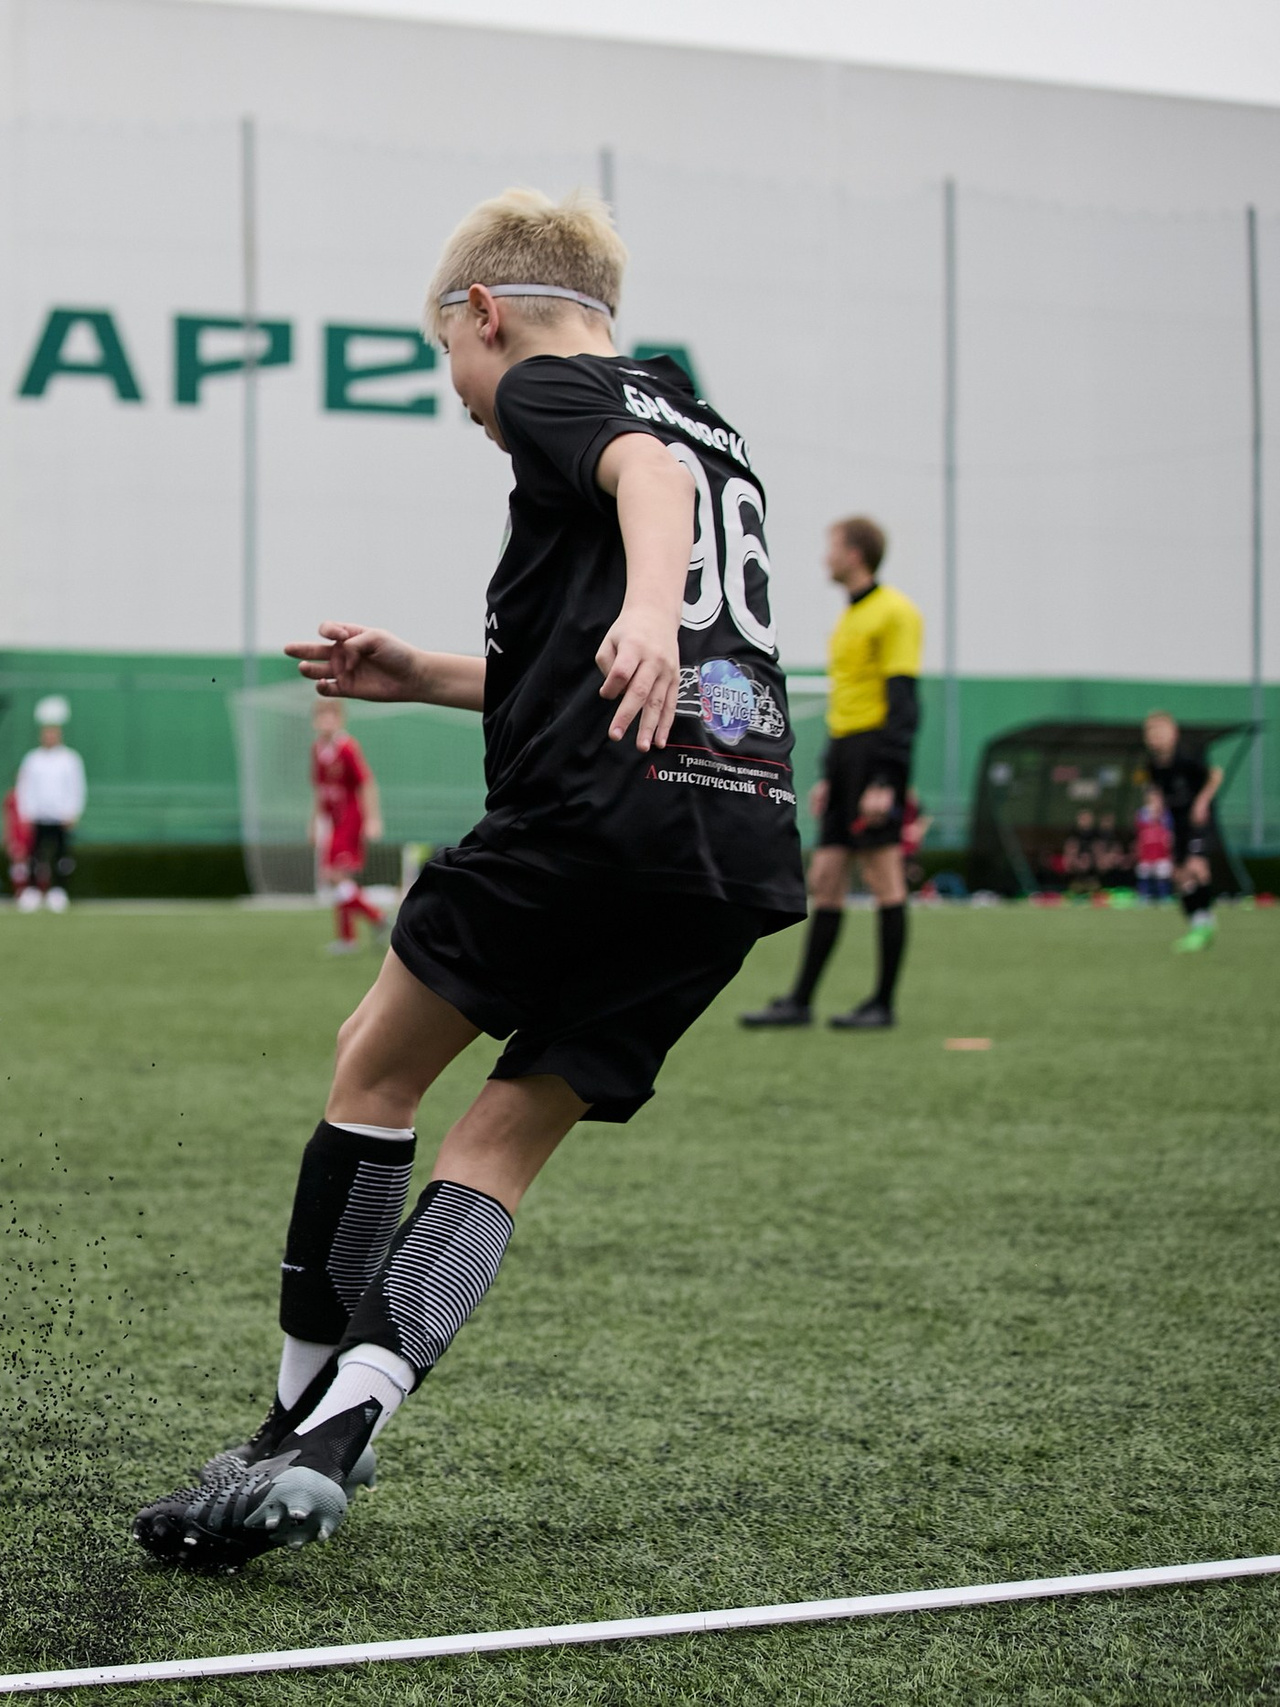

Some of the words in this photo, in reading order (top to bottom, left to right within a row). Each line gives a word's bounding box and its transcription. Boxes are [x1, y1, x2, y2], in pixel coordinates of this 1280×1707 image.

[666, 442, 777, 655] 96
[700, 697, 757, 722] SERVICE
[645, 764, 757, 795] Логистический
[758, 781, 797, 804] Сервис
